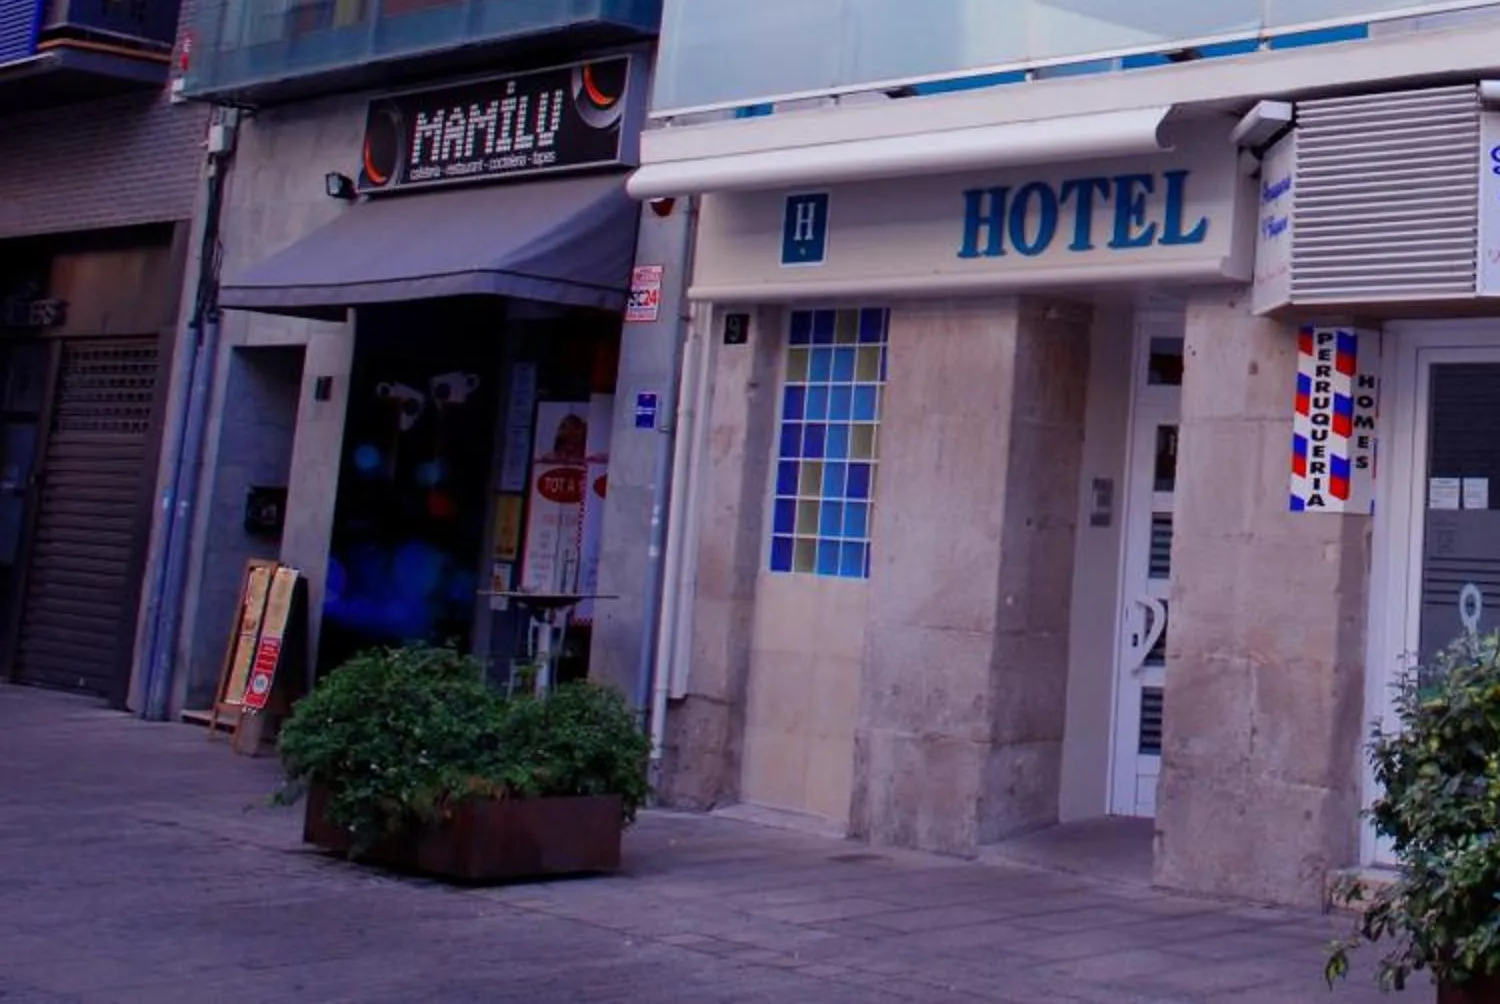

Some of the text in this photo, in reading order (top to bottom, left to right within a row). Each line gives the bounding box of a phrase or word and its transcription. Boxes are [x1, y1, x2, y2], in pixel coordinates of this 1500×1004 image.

[793, 202, 816, 241] H
[957, 169, 1208, 258] HOTEL
[1306, 332, 1333, 507] PERRUQUERIA
[1354, 374, 1374, 470] HOMES
